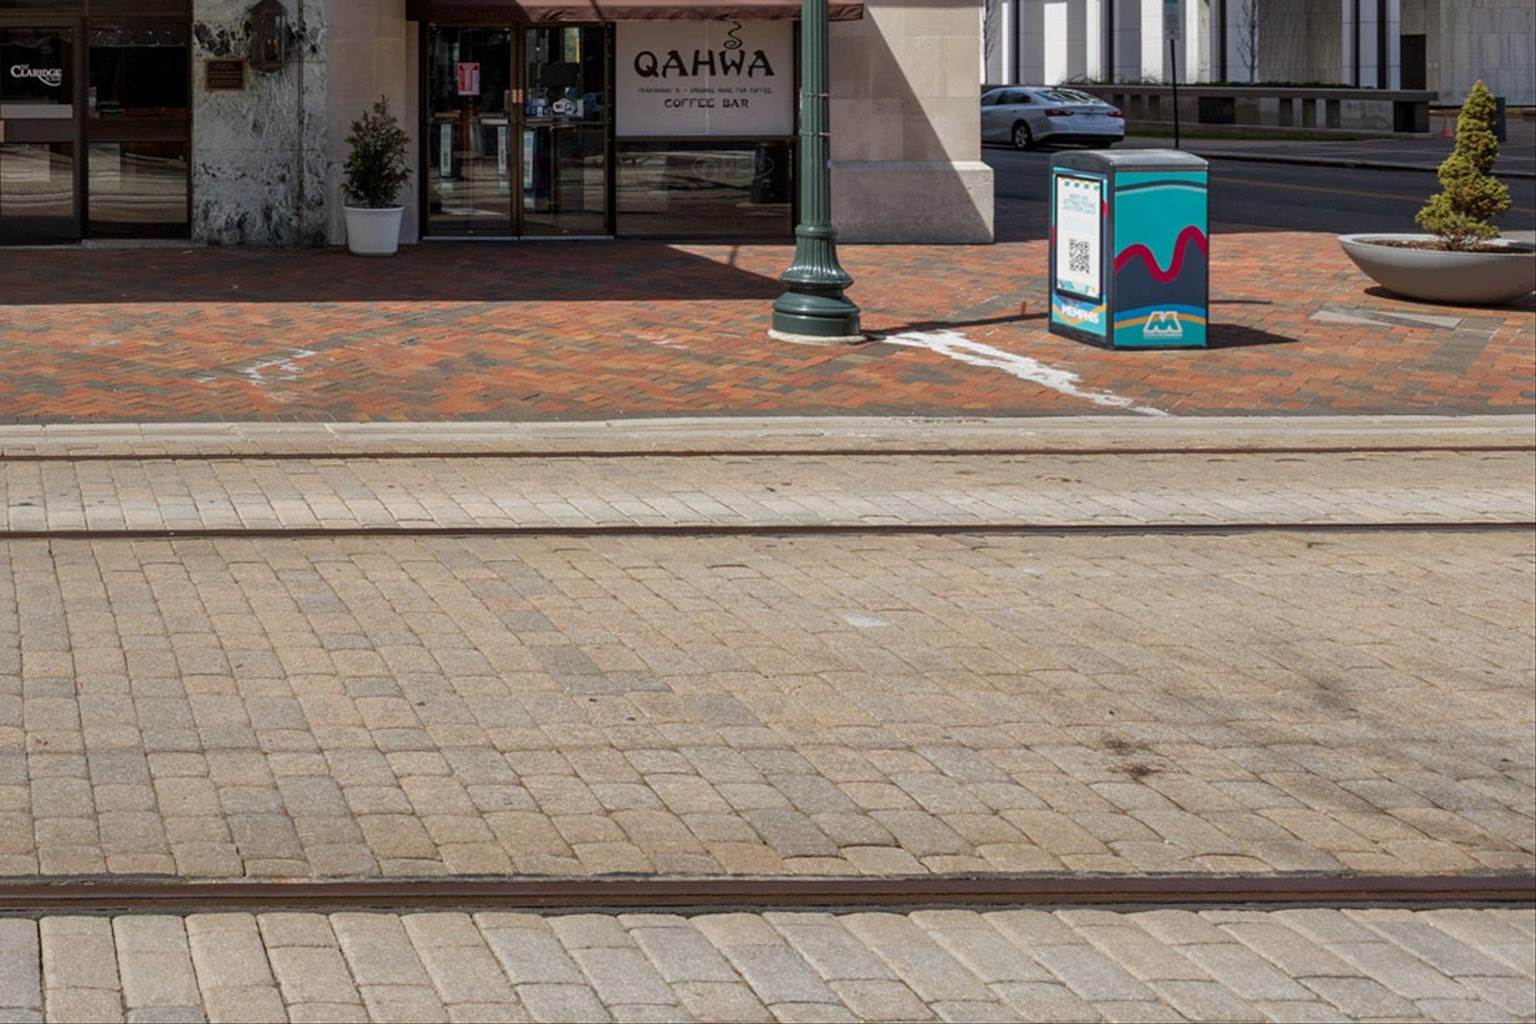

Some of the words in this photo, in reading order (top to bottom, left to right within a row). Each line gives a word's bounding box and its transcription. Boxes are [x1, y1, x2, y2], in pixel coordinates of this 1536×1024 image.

[634, 50, 775, 78] QAHWA
[10, 65, 62, 78] CLARIDGE
[664, 98, 715, 108] COFFEE
[722, 98, 749, 108] BAR
